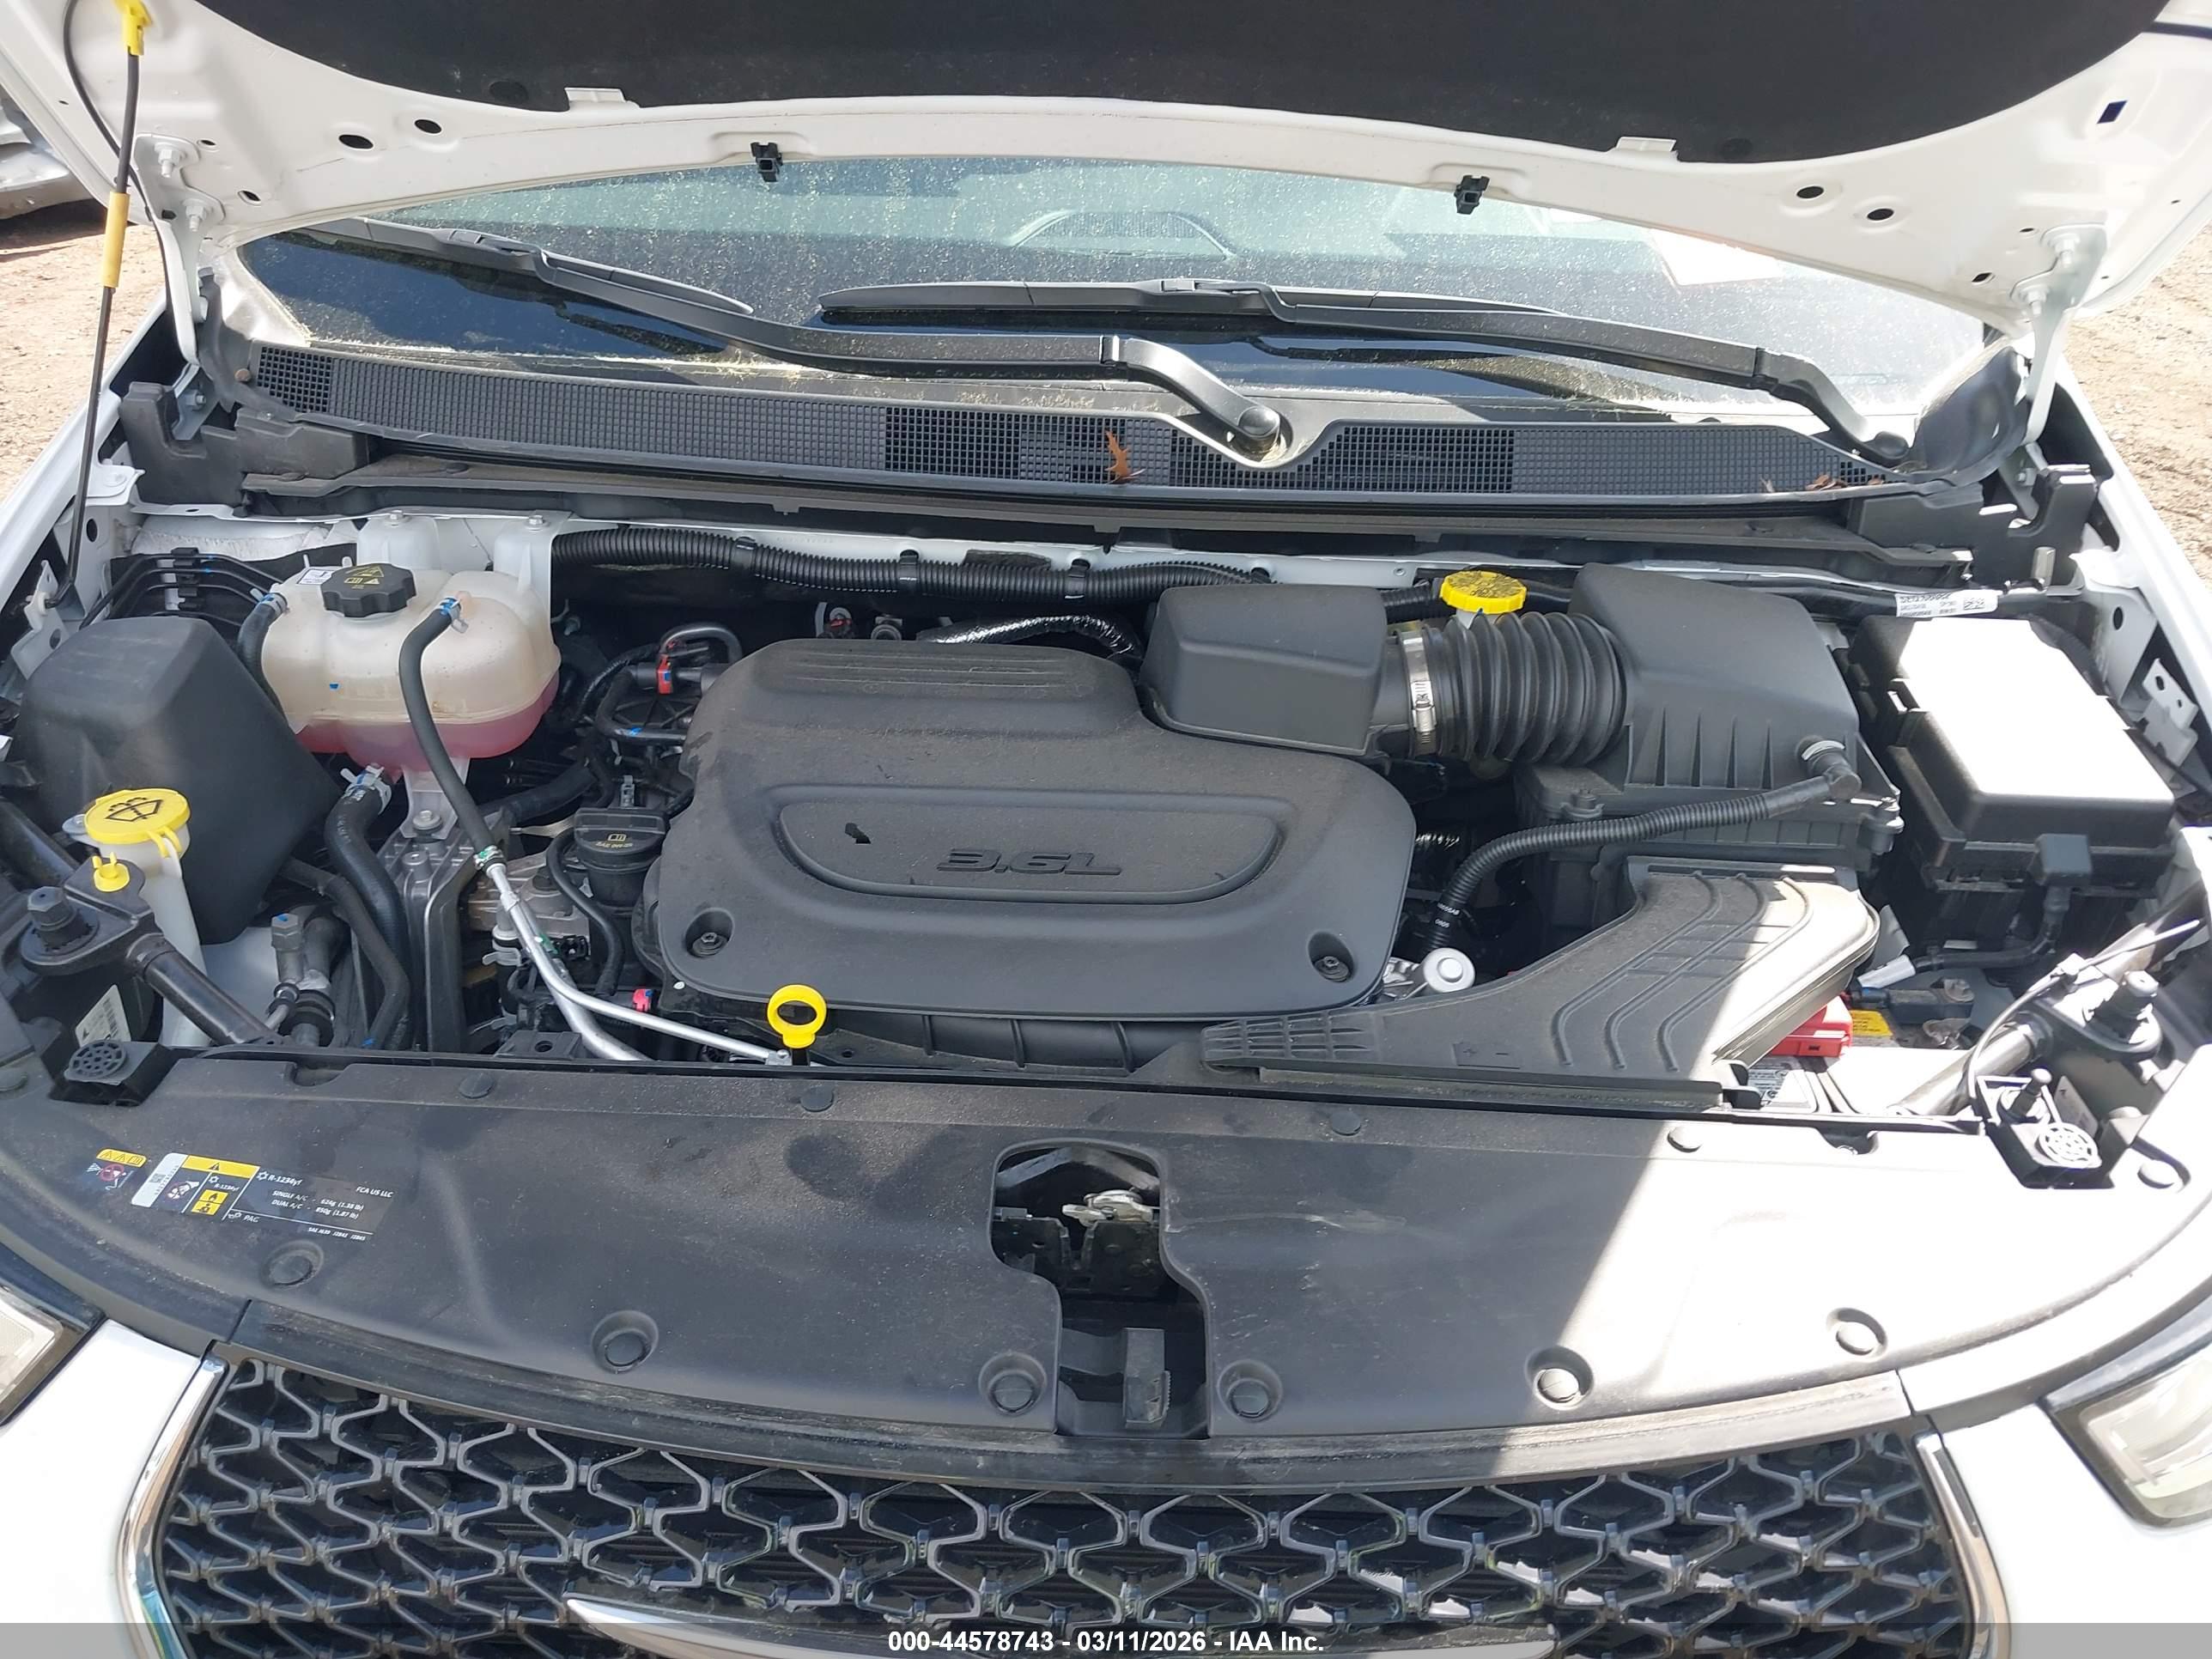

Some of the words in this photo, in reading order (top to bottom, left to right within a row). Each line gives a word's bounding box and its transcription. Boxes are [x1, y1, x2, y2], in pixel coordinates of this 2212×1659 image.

[936, 848, 1123, 876] 3.6L
[268, 1175, 303, 1187] R-1234yf
[271, 1199, 289, 1207] DUAL
